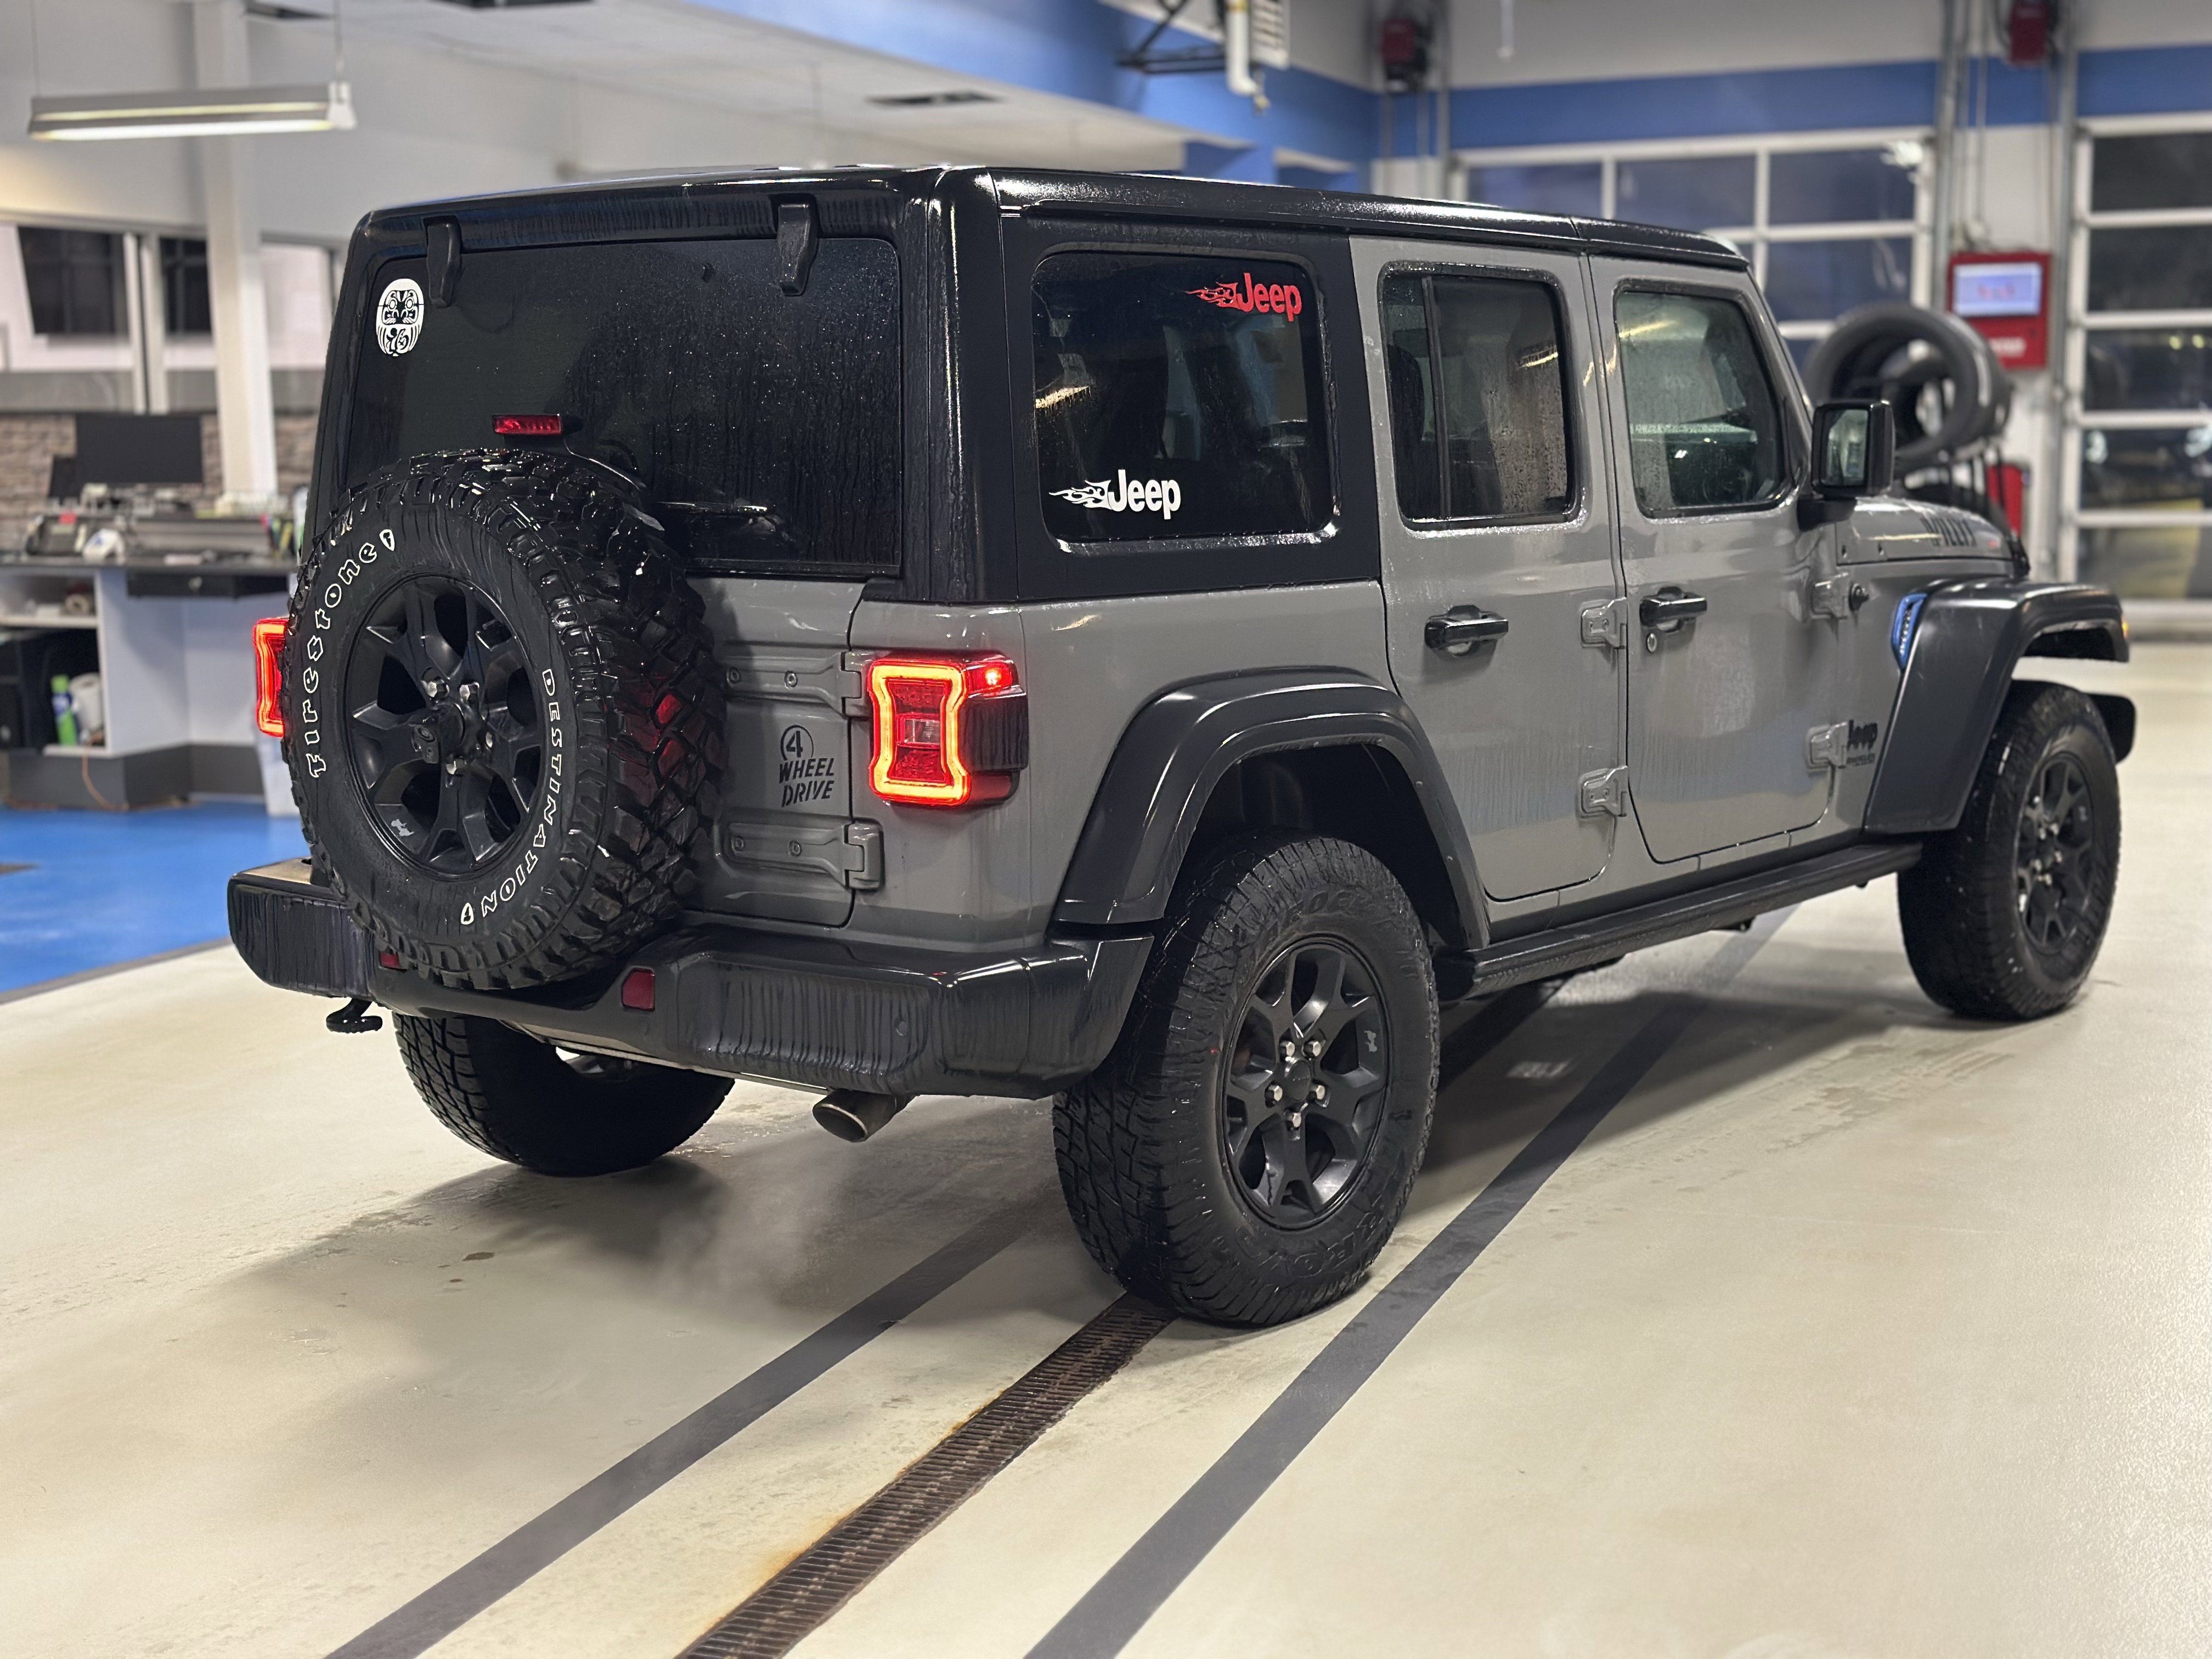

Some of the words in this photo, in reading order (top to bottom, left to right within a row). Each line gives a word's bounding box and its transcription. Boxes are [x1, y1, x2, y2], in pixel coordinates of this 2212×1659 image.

[1235, 272, 1302, 322] Jeep
[1107, 469, 1181, 520] Jeep
[302, 542, 377, 778] Firestone
[786, 730, 803, 758] 4
[481, 668, 562, 917] DESTINATION
[779, 758, 835, 783] WHEEL
[781, 780, 835, 808] DRIVE
